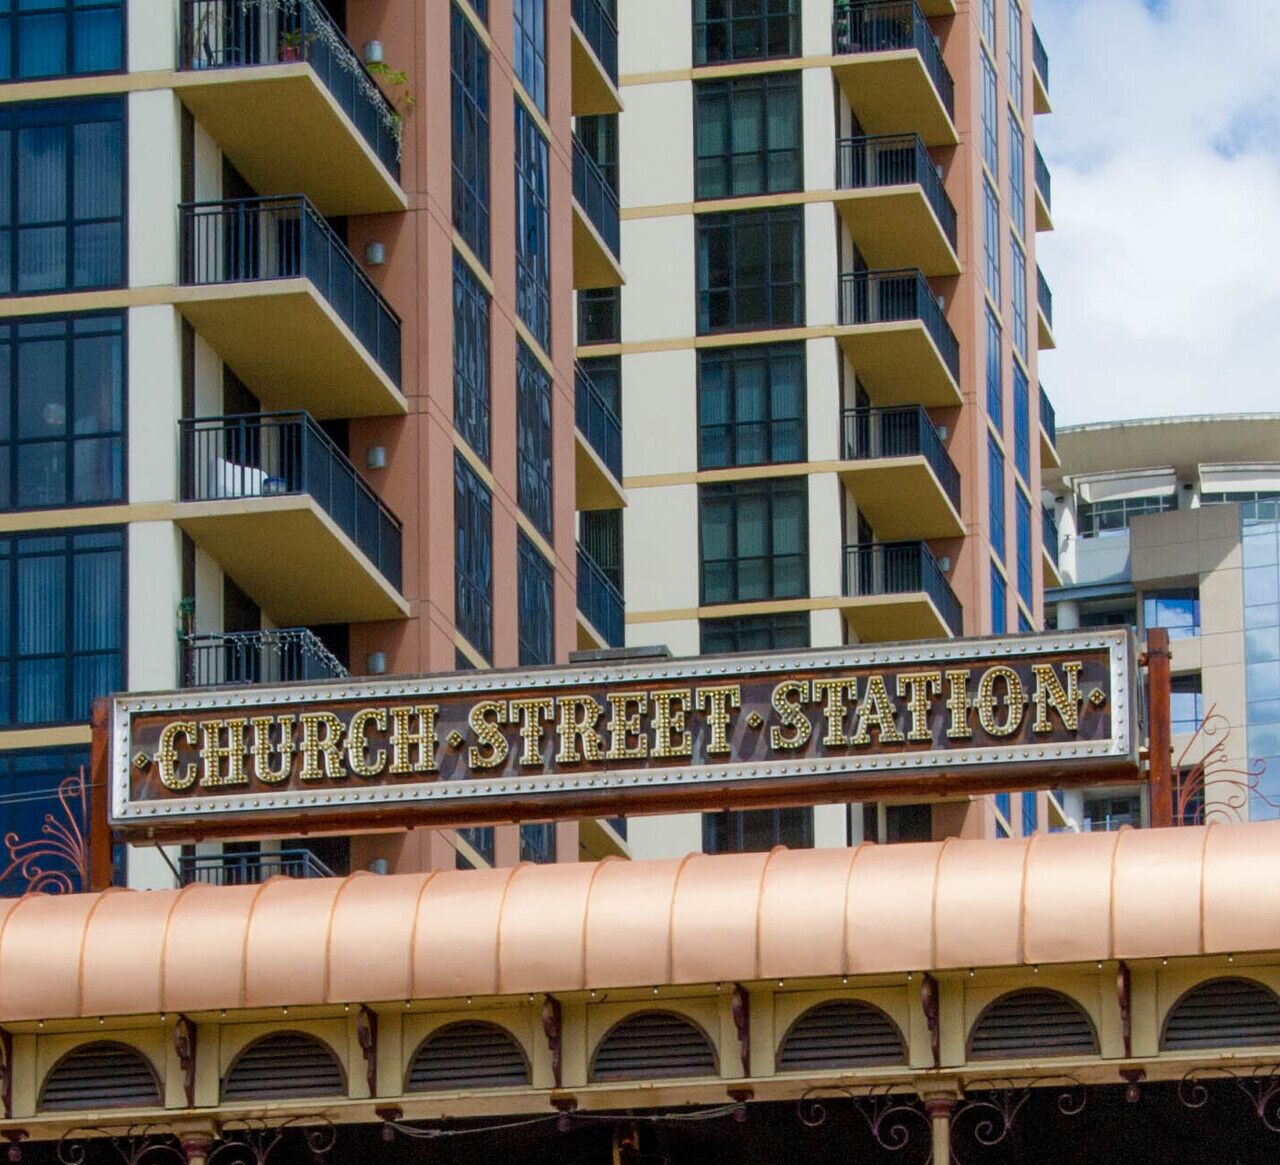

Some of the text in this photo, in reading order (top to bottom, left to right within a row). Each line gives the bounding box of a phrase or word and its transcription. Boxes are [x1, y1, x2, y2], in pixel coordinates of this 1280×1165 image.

[154, 661, 1083, 790] CHURCH STREET STATION
